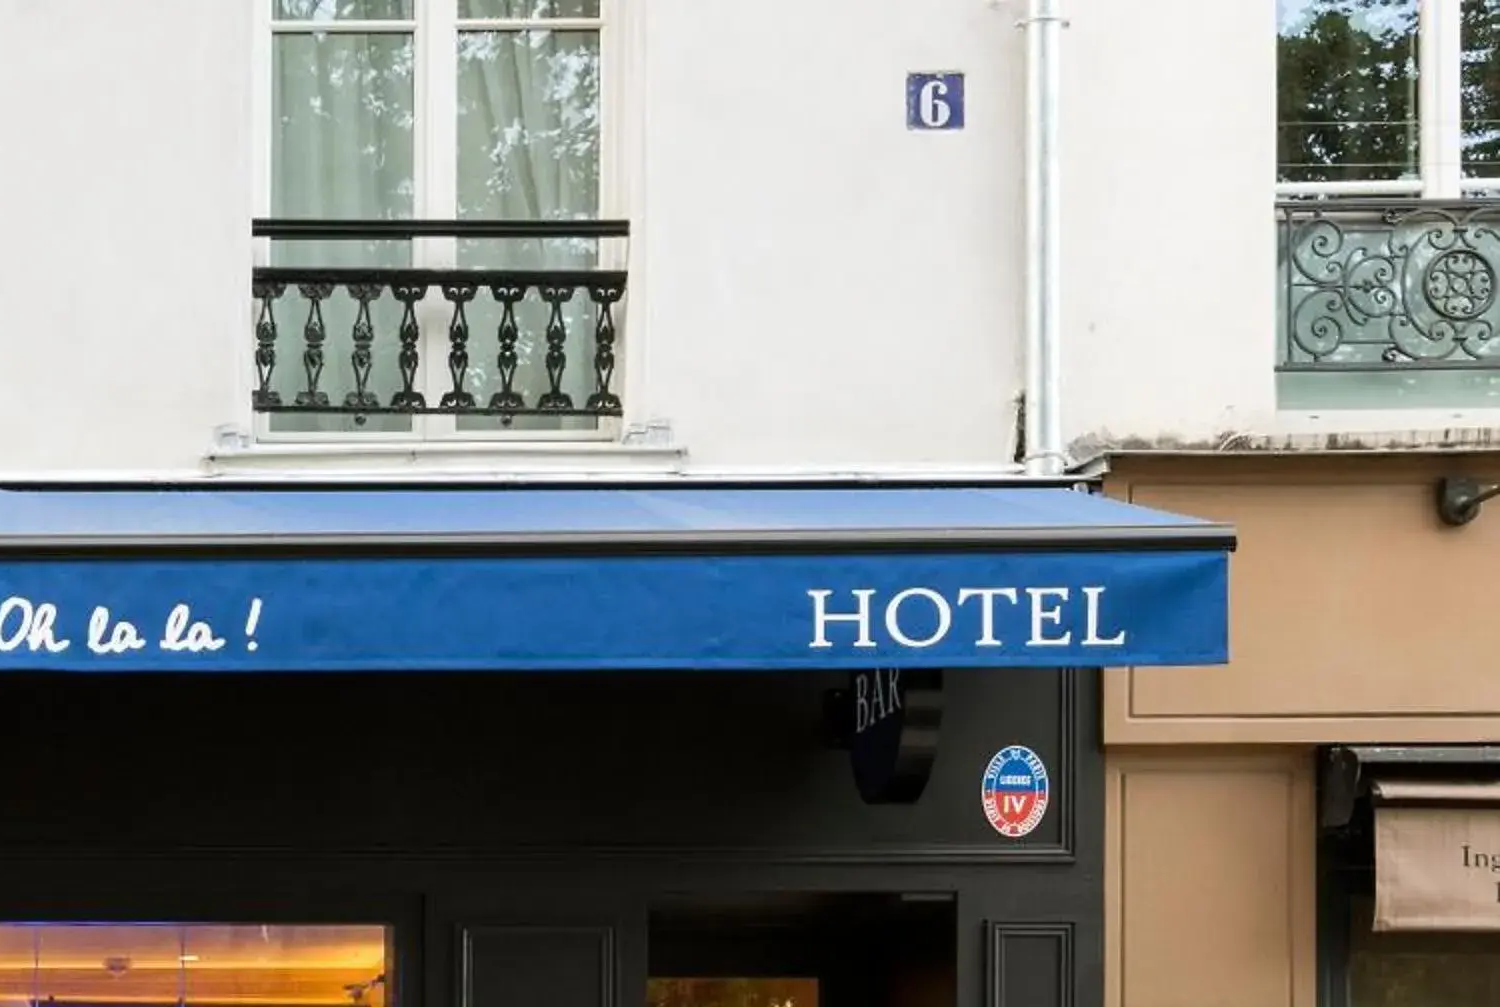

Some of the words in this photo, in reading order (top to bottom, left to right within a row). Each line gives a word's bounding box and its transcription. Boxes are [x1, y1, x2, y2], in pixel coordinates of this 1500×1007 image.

[920, 79, 951, 127] 6
[87, 606, 146, 653] la
[159, 603, 226, 653] la
[807, 587, 1126, 648] HOTEL
[855, 667, 902, 733] BAR
[1003, 795, 1027, 814] IV
